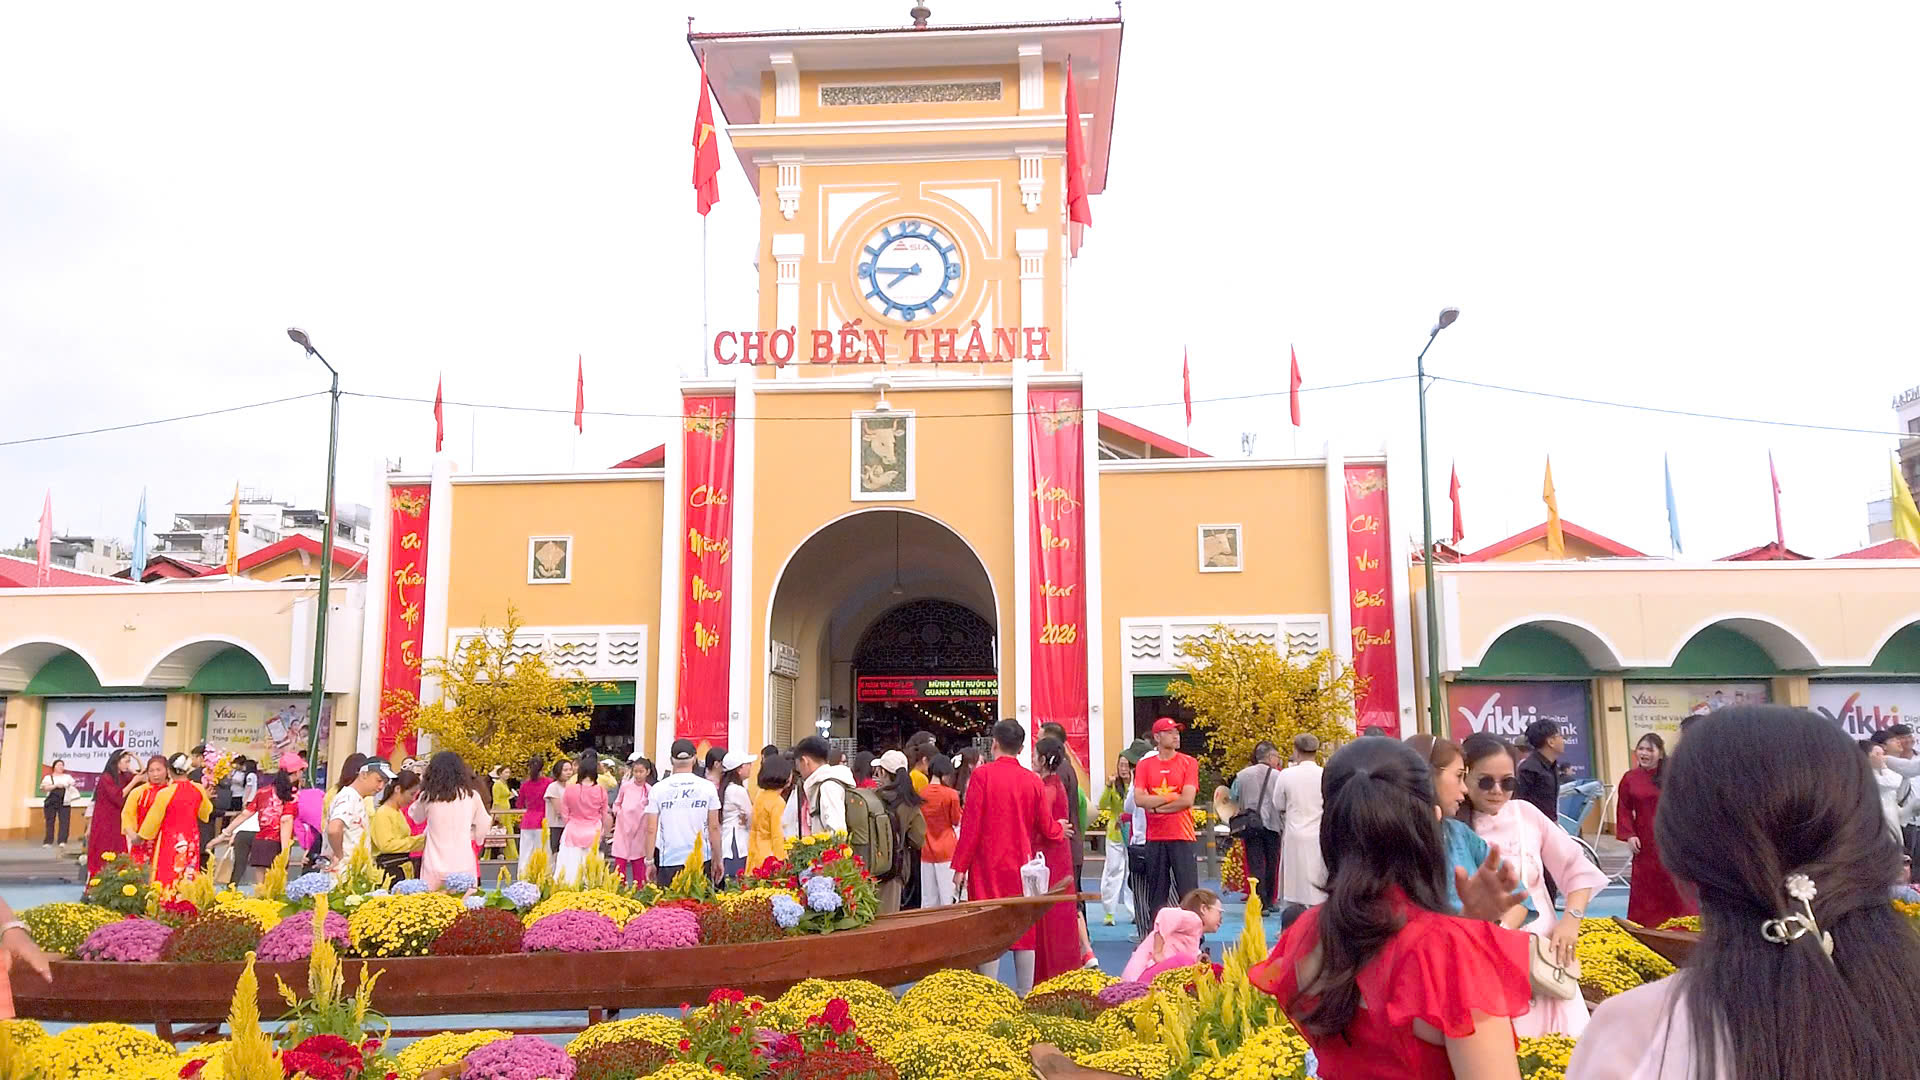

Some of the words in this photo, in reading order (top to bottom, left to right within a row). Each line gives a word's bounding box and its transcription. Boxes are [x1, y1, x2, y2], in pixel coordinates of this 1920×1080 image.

[899, 220, 921, 235] 12
[714, 325, 796, 368] CHỢ
[810, 318, 886, 364] BẾN
[904, 320, 1050, 363] THÀNH
[689, 485, 729, 508] Chúc
[1032, 476, 1081, 520] Happy
[1355, 548, 1379, 571] Vui
[1040, 579, 1076, 597] Year
[1353, 588, 1385, 608] Bến
[693, 621, 720, 657] Mới
[1039, 623, 1077, 645] 2026
[1632, 692, 1657, 705] Vikki
[214, 706, 236, 719] Vikki
[1458, 692, 1537, 735] Vikki
[1818, 692, 1899, 735] Vikki
[56, 708, 126, 748] Vikki
[129, 730, 154, 738] Digital
[128, 737, 159, 748] Bank
